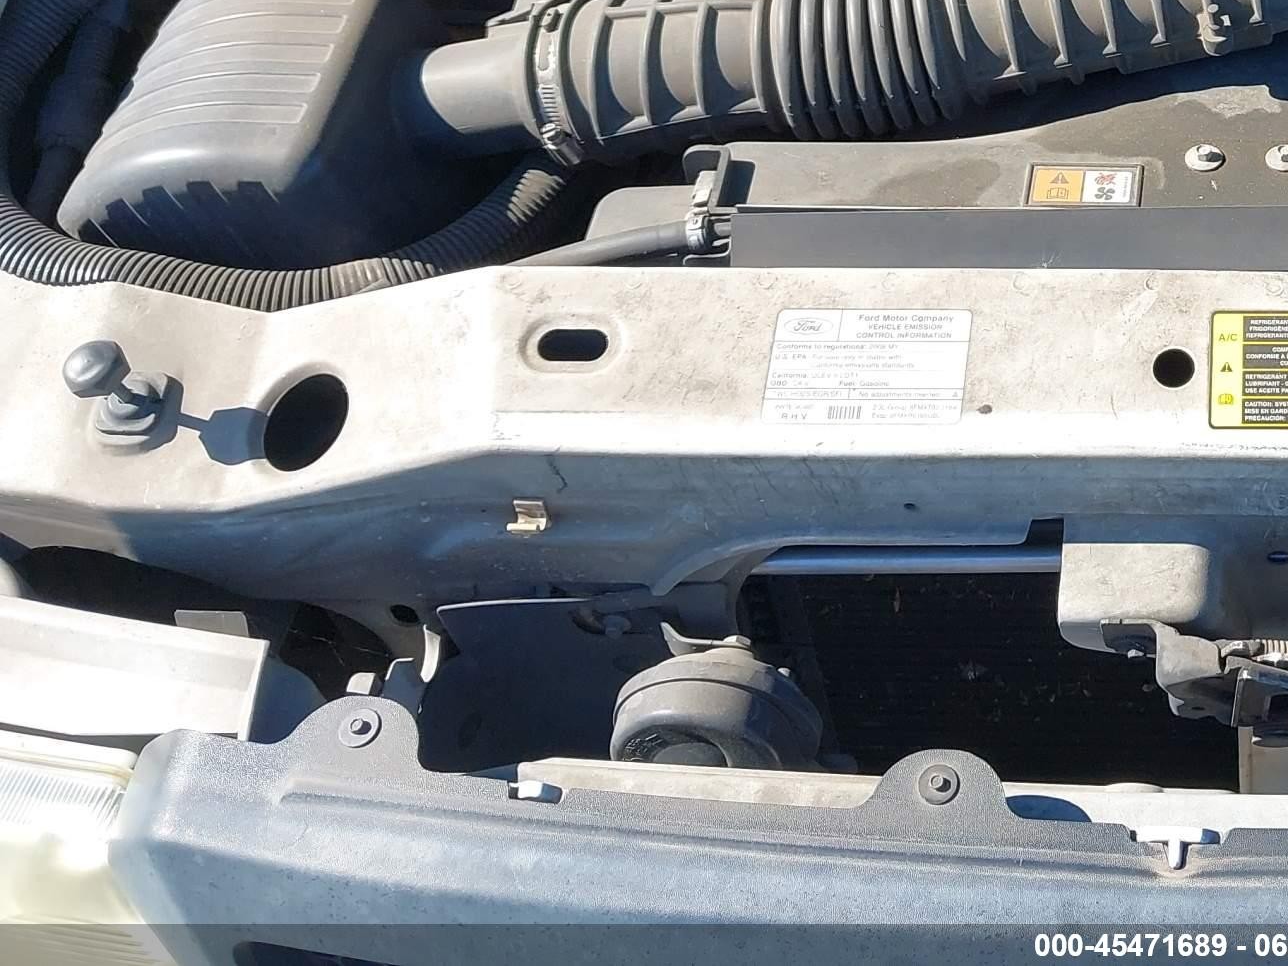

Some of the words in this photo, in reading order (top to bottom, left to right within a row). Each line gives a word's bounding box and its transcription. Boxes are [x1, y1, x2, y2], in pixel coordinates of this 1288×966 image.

[858, 314, 880, 322] Ford
[883, 314, 908, 322] Motor
[911, 314, 954, 323] Company
[793, 320, 823, 332] Ford
[1218, 333, 1238, 342] A/C
